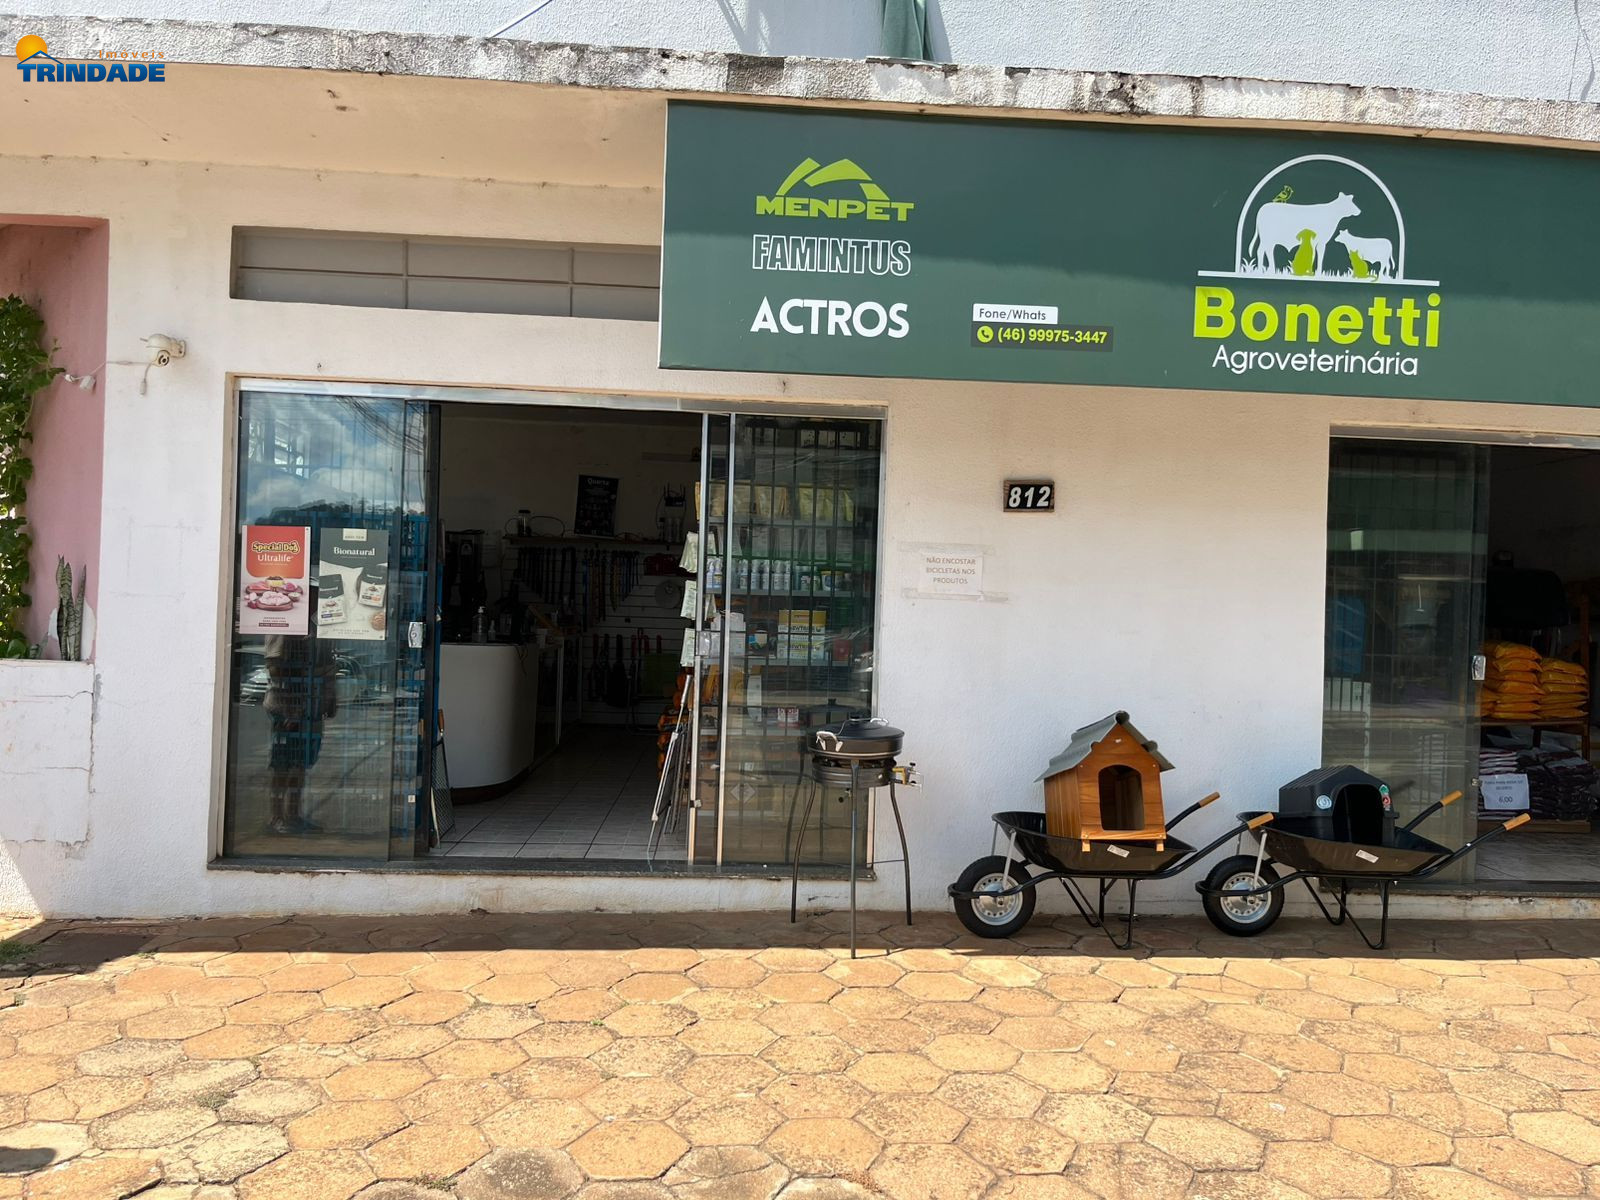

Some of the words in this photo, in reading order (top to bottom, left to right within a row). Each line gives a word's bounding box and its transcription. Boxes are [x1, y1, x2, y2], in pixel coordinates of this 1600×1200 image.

[754, 195, 914, 221] MENPET
[752, 234, 911, 276] FAMINTUS
[750, 296, 910, 338] ACTROS
[979, 308, 1047, 321] Fone/Whats
[1193, 285, 1441, 348] Bonetti
[997, 327, 1026, 344] (46)
[1028, 328, 1108, 345] 99975-3447
[1212, 344, 1418, 376] Agroveterinária
[1008, 486, 1051, 508] 812
[252, 541, 282, 553] Special
[283, 540, 300, 554] Dog
[333, 546, 376, 556] Bionatural
[257, 553, 292, 562] Ultralife
[926, 556, 941, 564] NÃO
[941, 557, 976, 565] ENCOSTAR
